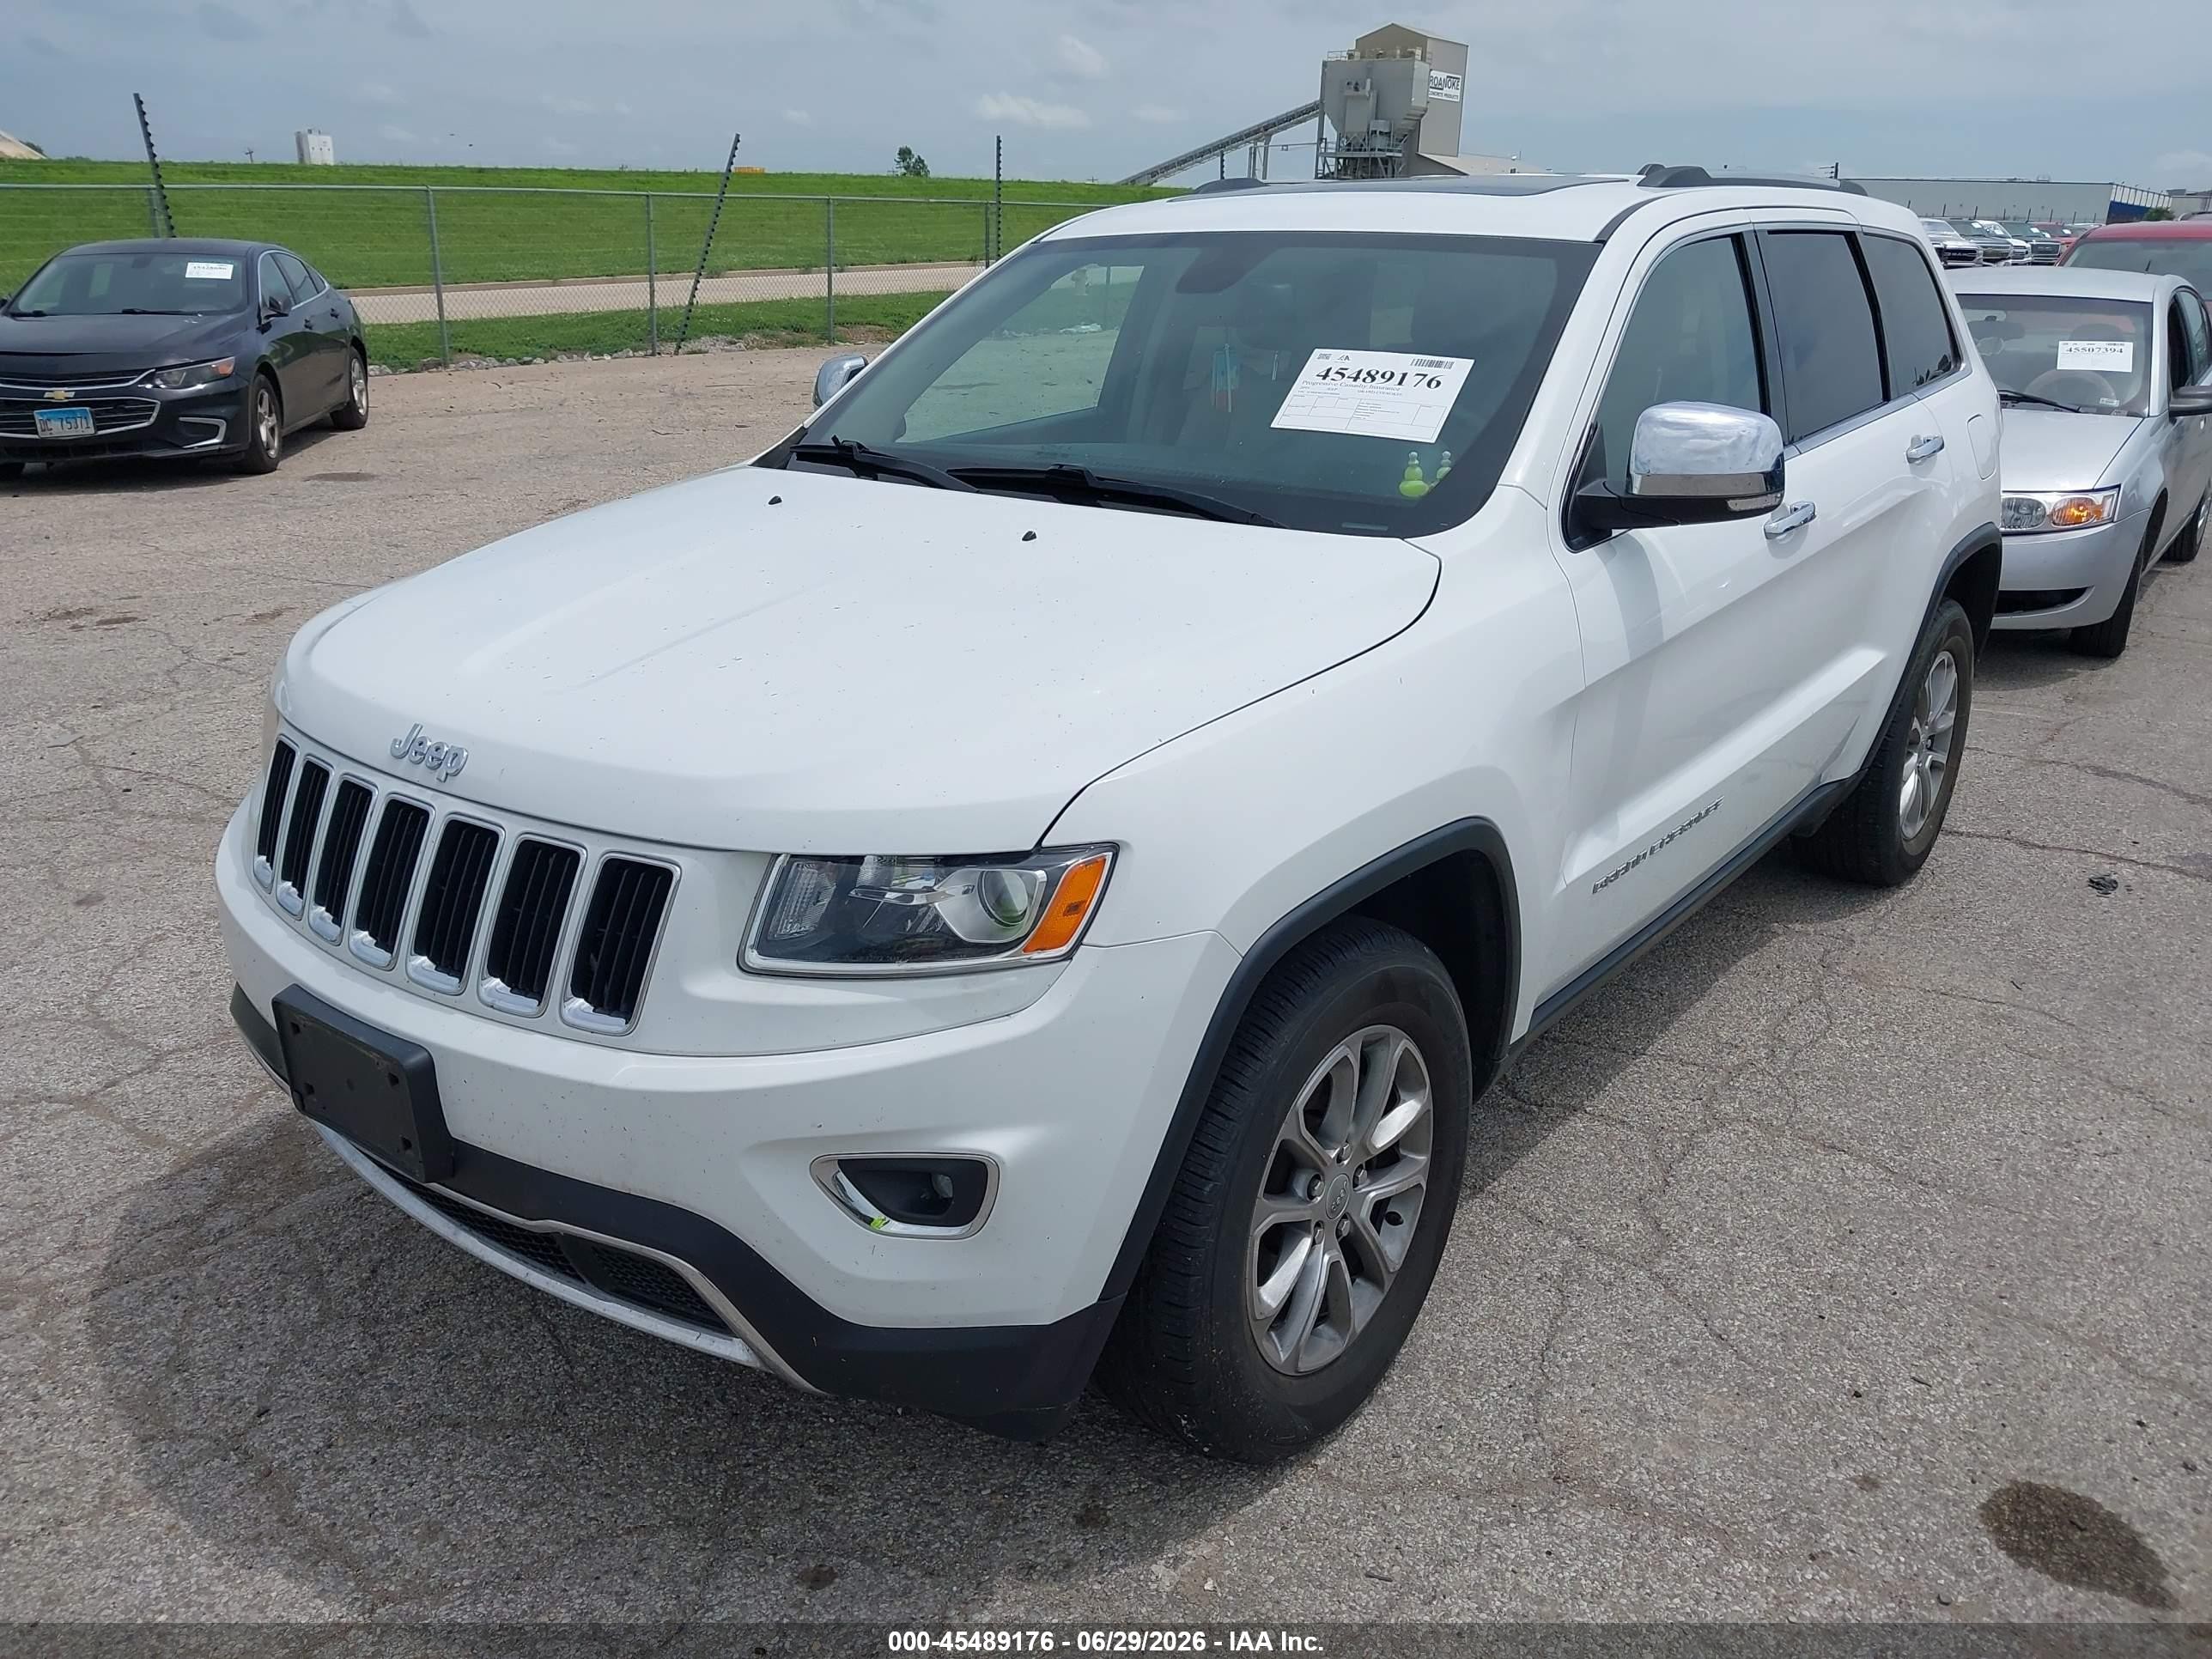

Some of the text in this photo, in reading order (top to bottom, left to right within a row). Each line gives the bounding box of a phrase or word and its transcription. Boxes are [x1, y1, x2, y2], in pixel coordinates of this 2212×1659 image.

[1429, 75, 1461, 90] ROANOKE
[1316, 366, 1446, 390] 45489176
[390, 723, 469, 783] Jeep
